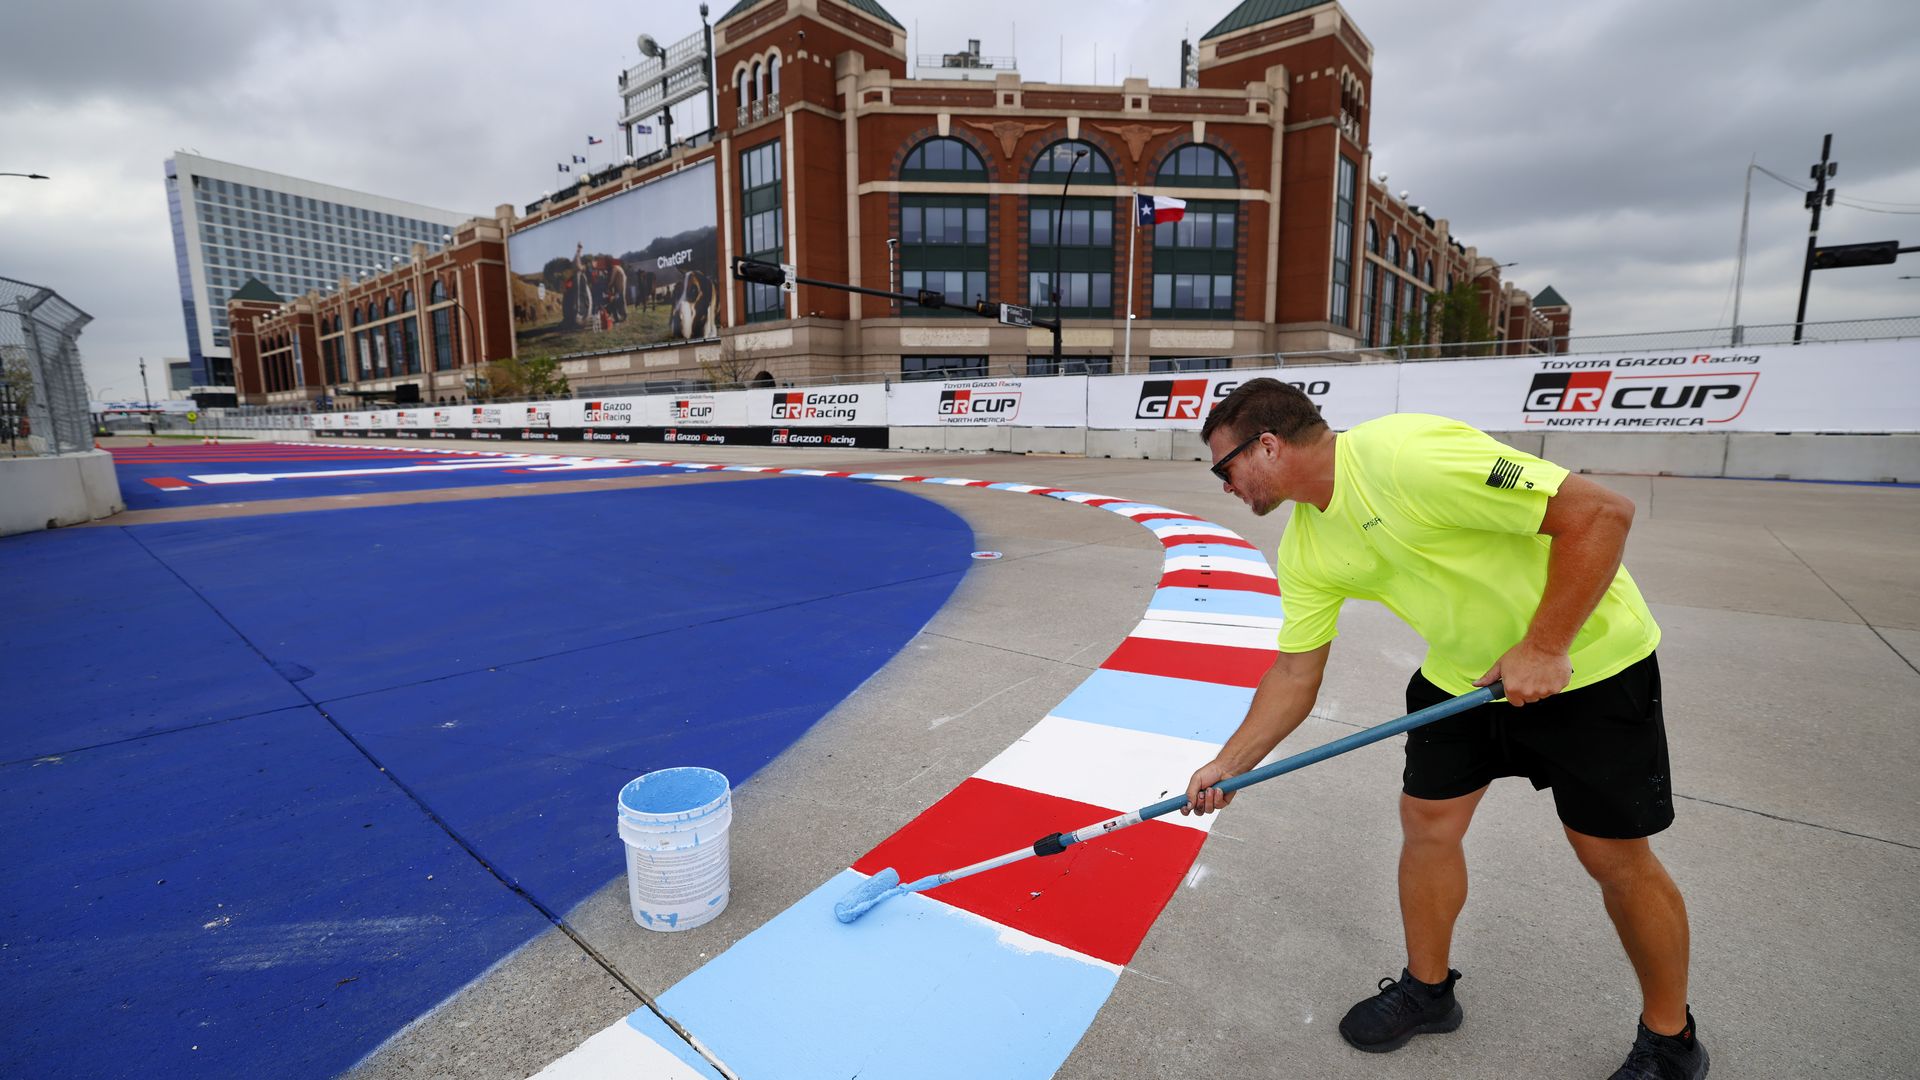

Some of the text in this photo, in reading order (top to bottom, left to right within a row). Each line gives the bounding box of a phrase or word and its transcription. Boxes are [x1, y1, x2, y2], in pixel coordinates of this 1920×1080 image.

[657, 248, 693, 269] ChatGPT
[1541, 354, 1760, 370] TOYOTA GAZOO Racing
[807, 393, 859, 404] GAZOO
[1526, 384, 1741, 410] GR CUP
[603, 402, 632, 411] GAZOO
[690, 407, 712, 417] CUP
[772, 403, 802, 419] GR
[940, 399, 1016, 413] GR CUP
[1138, 395, 1202, 418] GR
[603, 412, 631, 424] Racing
[805, 406, 856, 421] Racing
[1547, 417, 1704, 427] NORTH AMERICA
[664, 433, 725, 443] GR GAZOO Racing
[772, 434, 856, 446] GR GAZOO Racing
